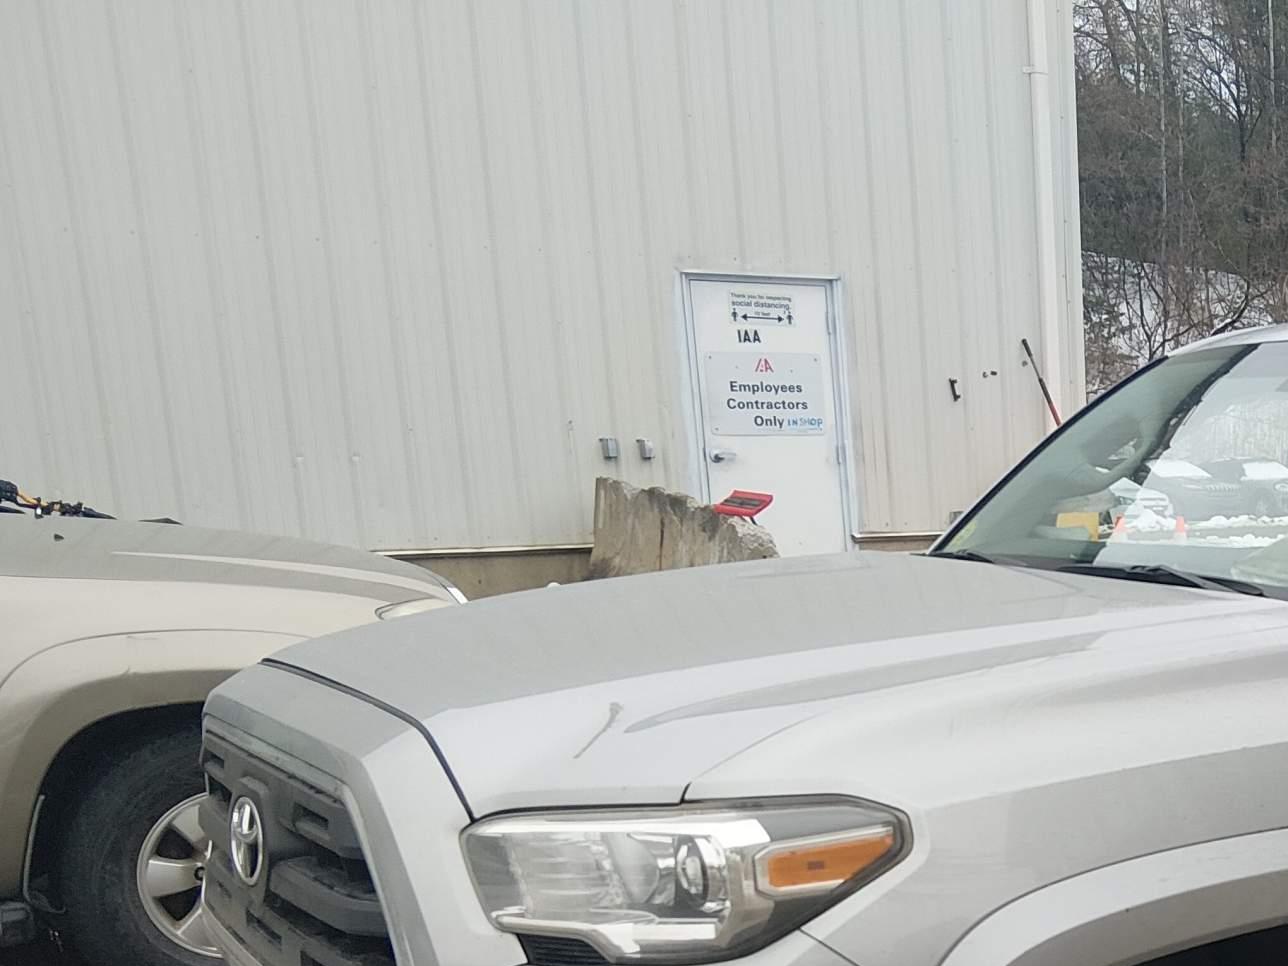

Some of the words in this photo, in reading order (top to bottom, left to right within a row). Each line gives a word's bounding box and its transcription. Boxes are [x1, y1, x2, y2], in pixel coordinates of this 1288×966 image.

[737, 329, 761, 343] IAA
[729, 380, 803, 395] Employees
[726, 398, 808, 410] Contractors
[754, 415, 784, 429] Only
